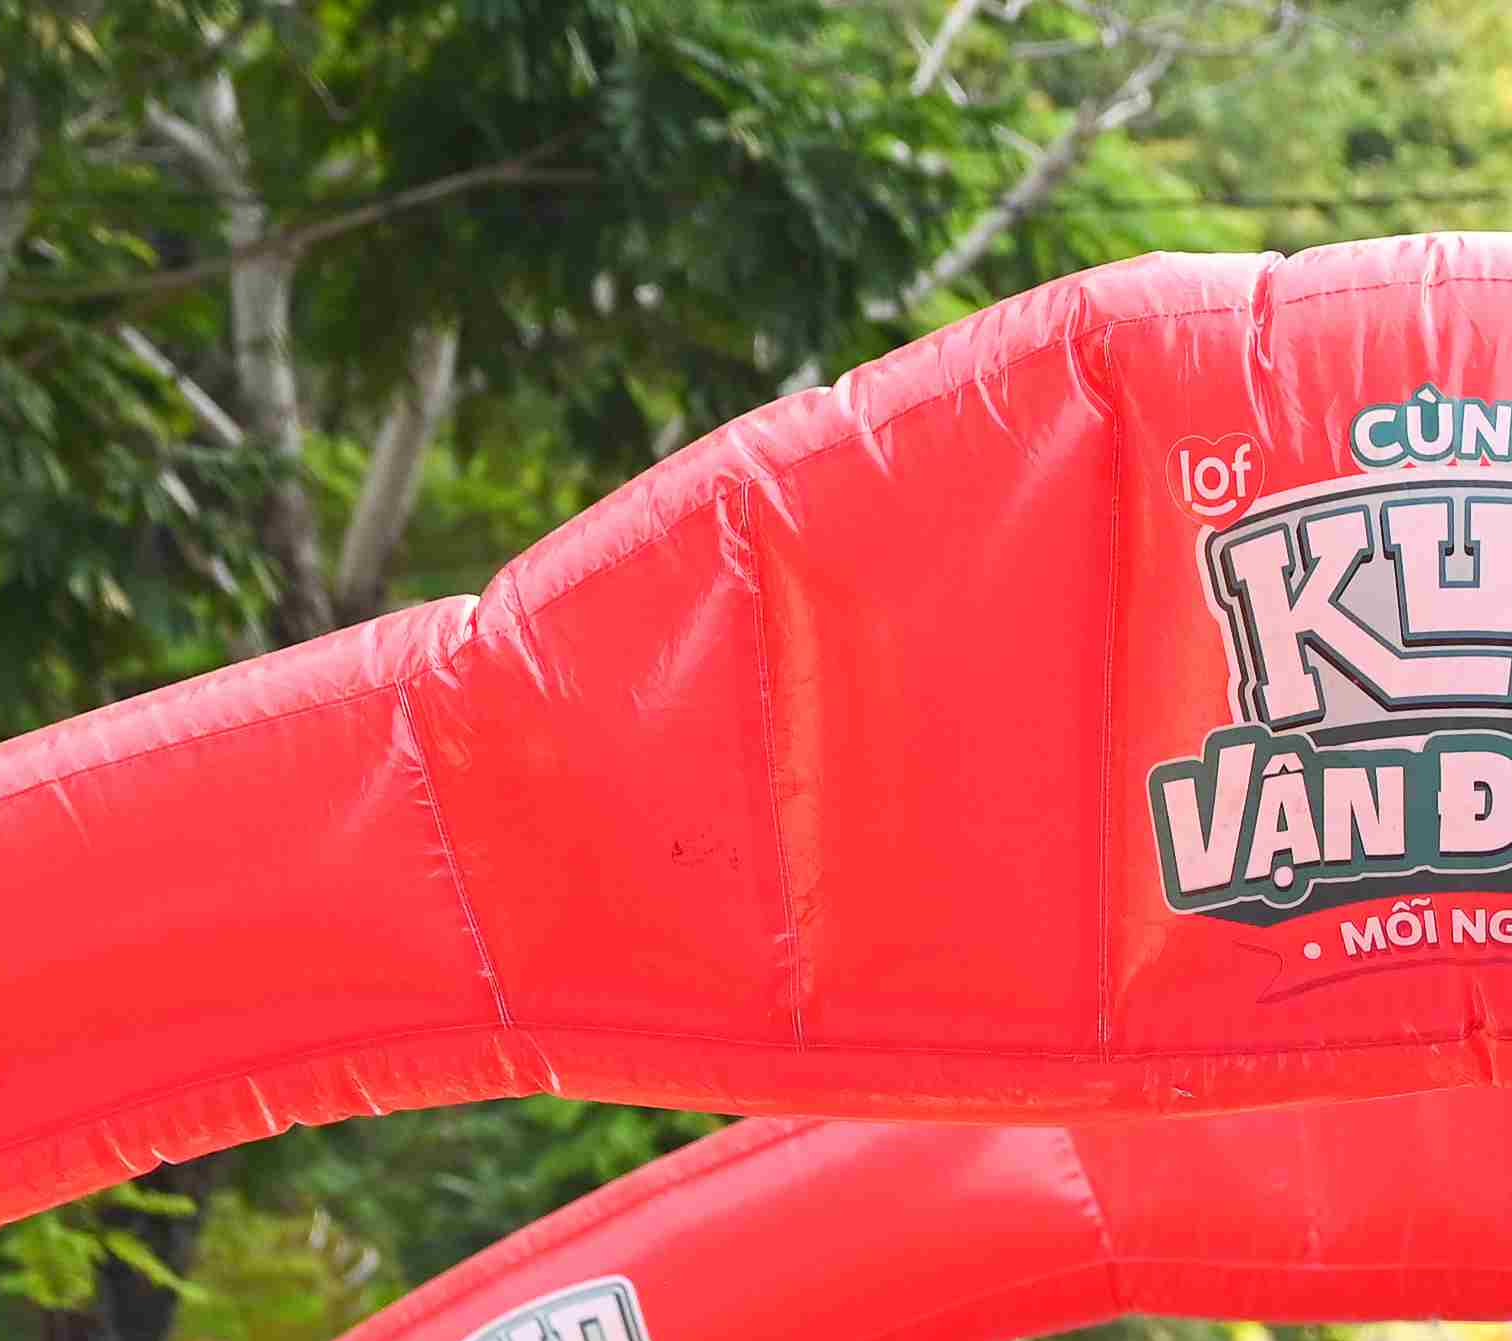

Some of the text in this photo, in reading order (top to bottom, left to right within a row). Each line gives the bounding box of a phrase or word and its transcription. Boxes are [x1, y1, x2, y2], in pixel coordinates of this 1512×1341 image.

[1180, 443, 1252, 501] lof
[1160, 742, 1406, 895] VẬN
[1340, 898, 1440, 958] MỖI
